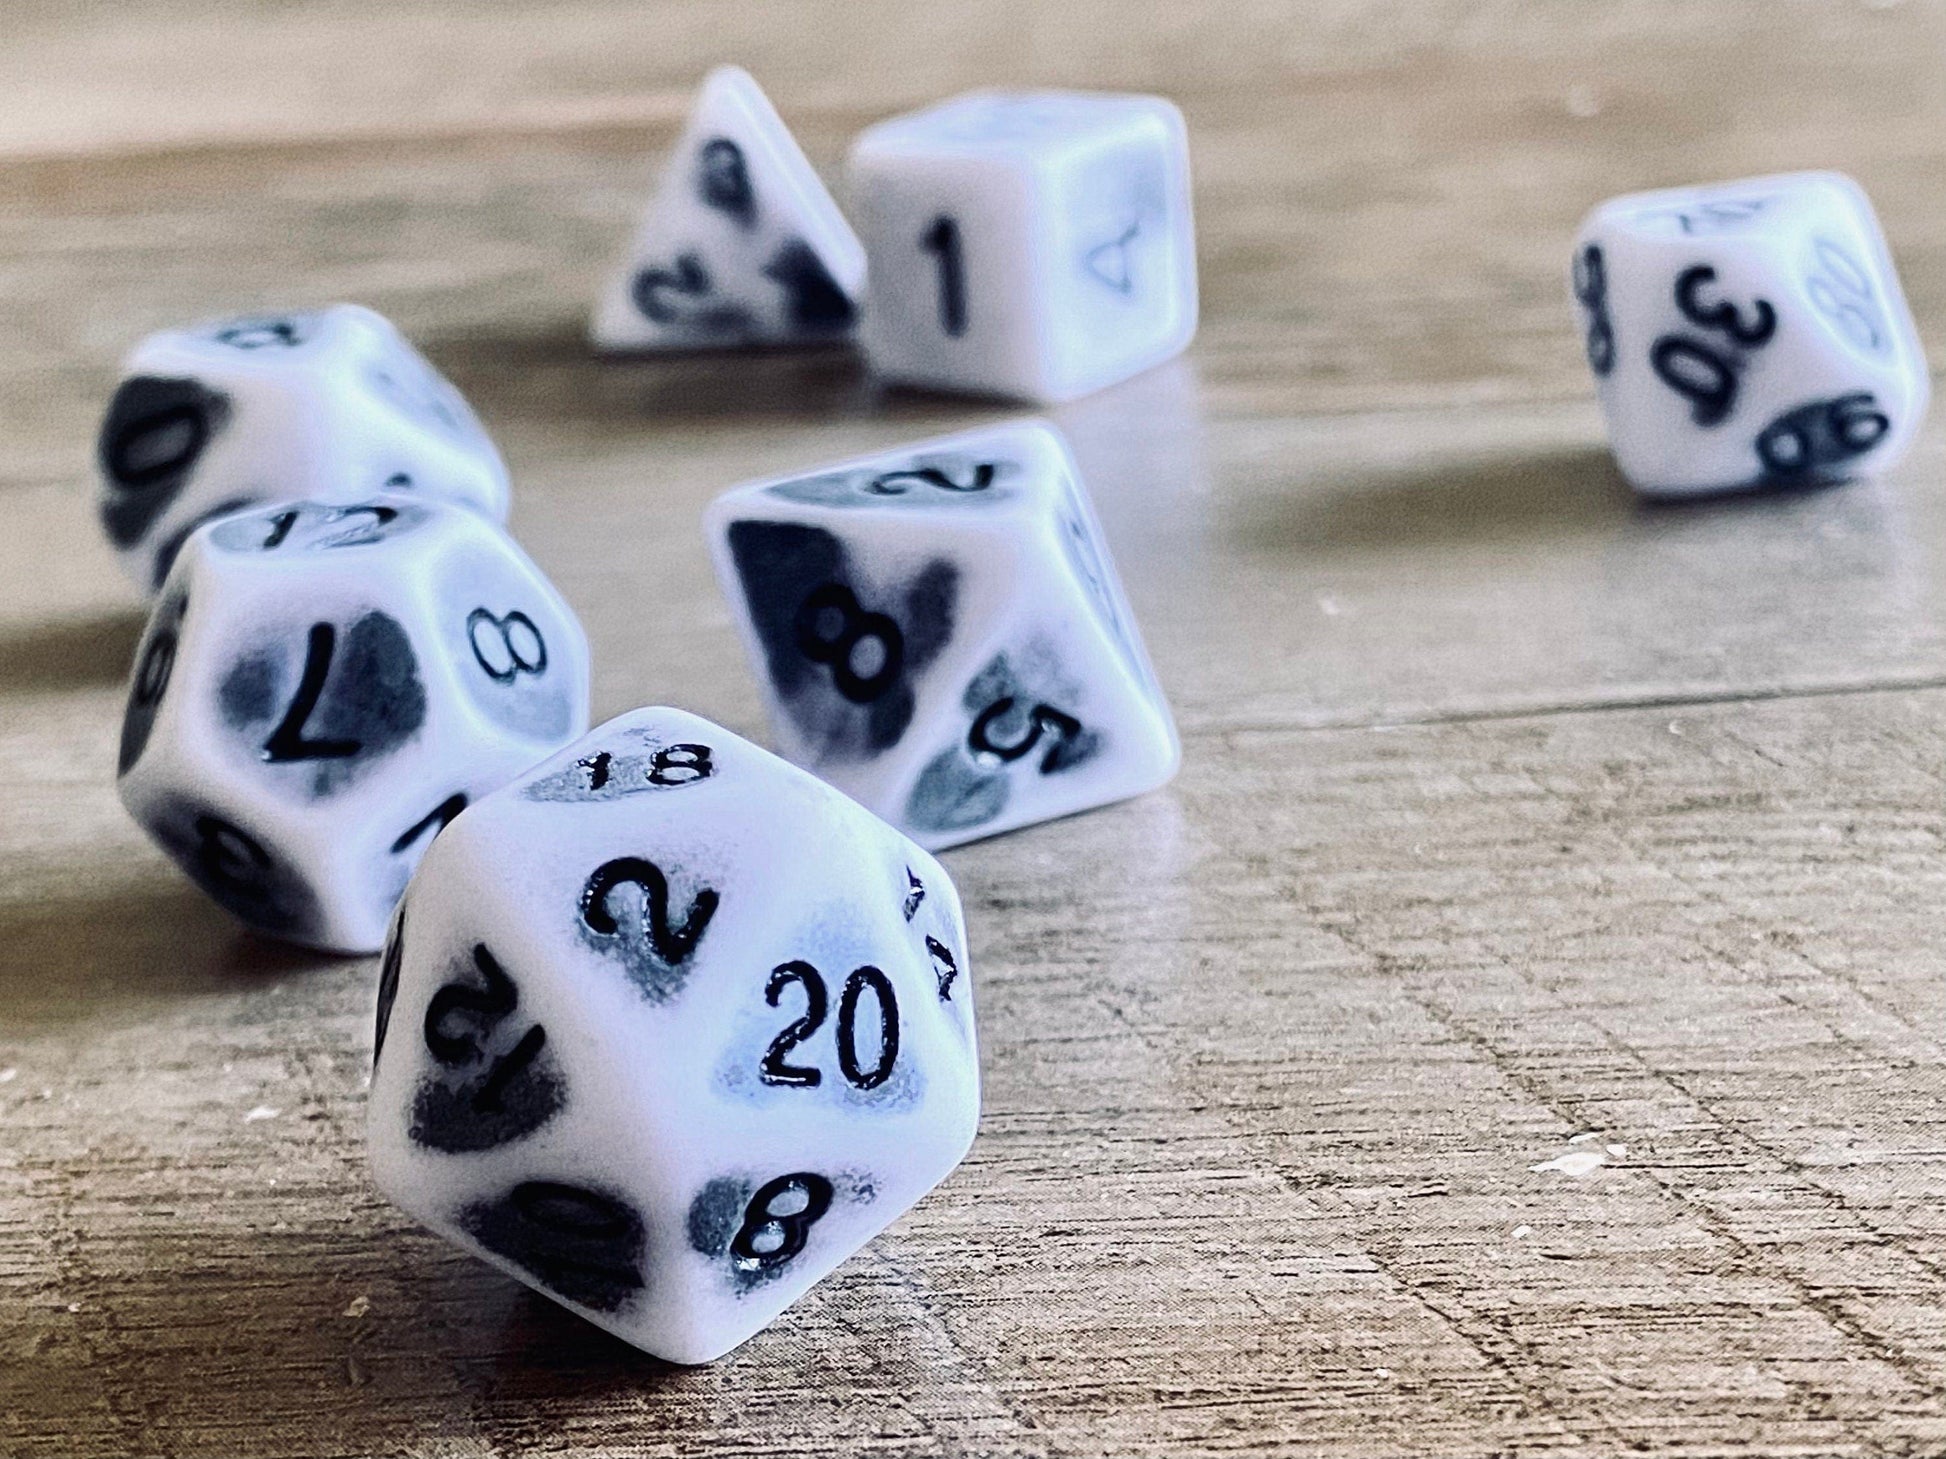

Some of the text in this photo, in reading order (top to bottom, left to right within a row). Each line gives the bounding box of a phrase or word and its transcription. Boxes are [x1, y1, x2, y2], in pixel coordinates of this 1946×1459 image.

[921, 213, 969, 341] 1
[1651, 262, 1778, 408] 30
[867, 461, 996, 497] 2
[262, 621, 363, 763] 7
[465, 606, 549, 686] 8
[797, 582, 905, 706] 8
[576, 742, 715, 793] 18
[967, 696, 1081, 777] 5
[582, 855, 721, 968] 2
[758, 959, 901, 1091] 20
[729, 1171, 834, 1273] 8
